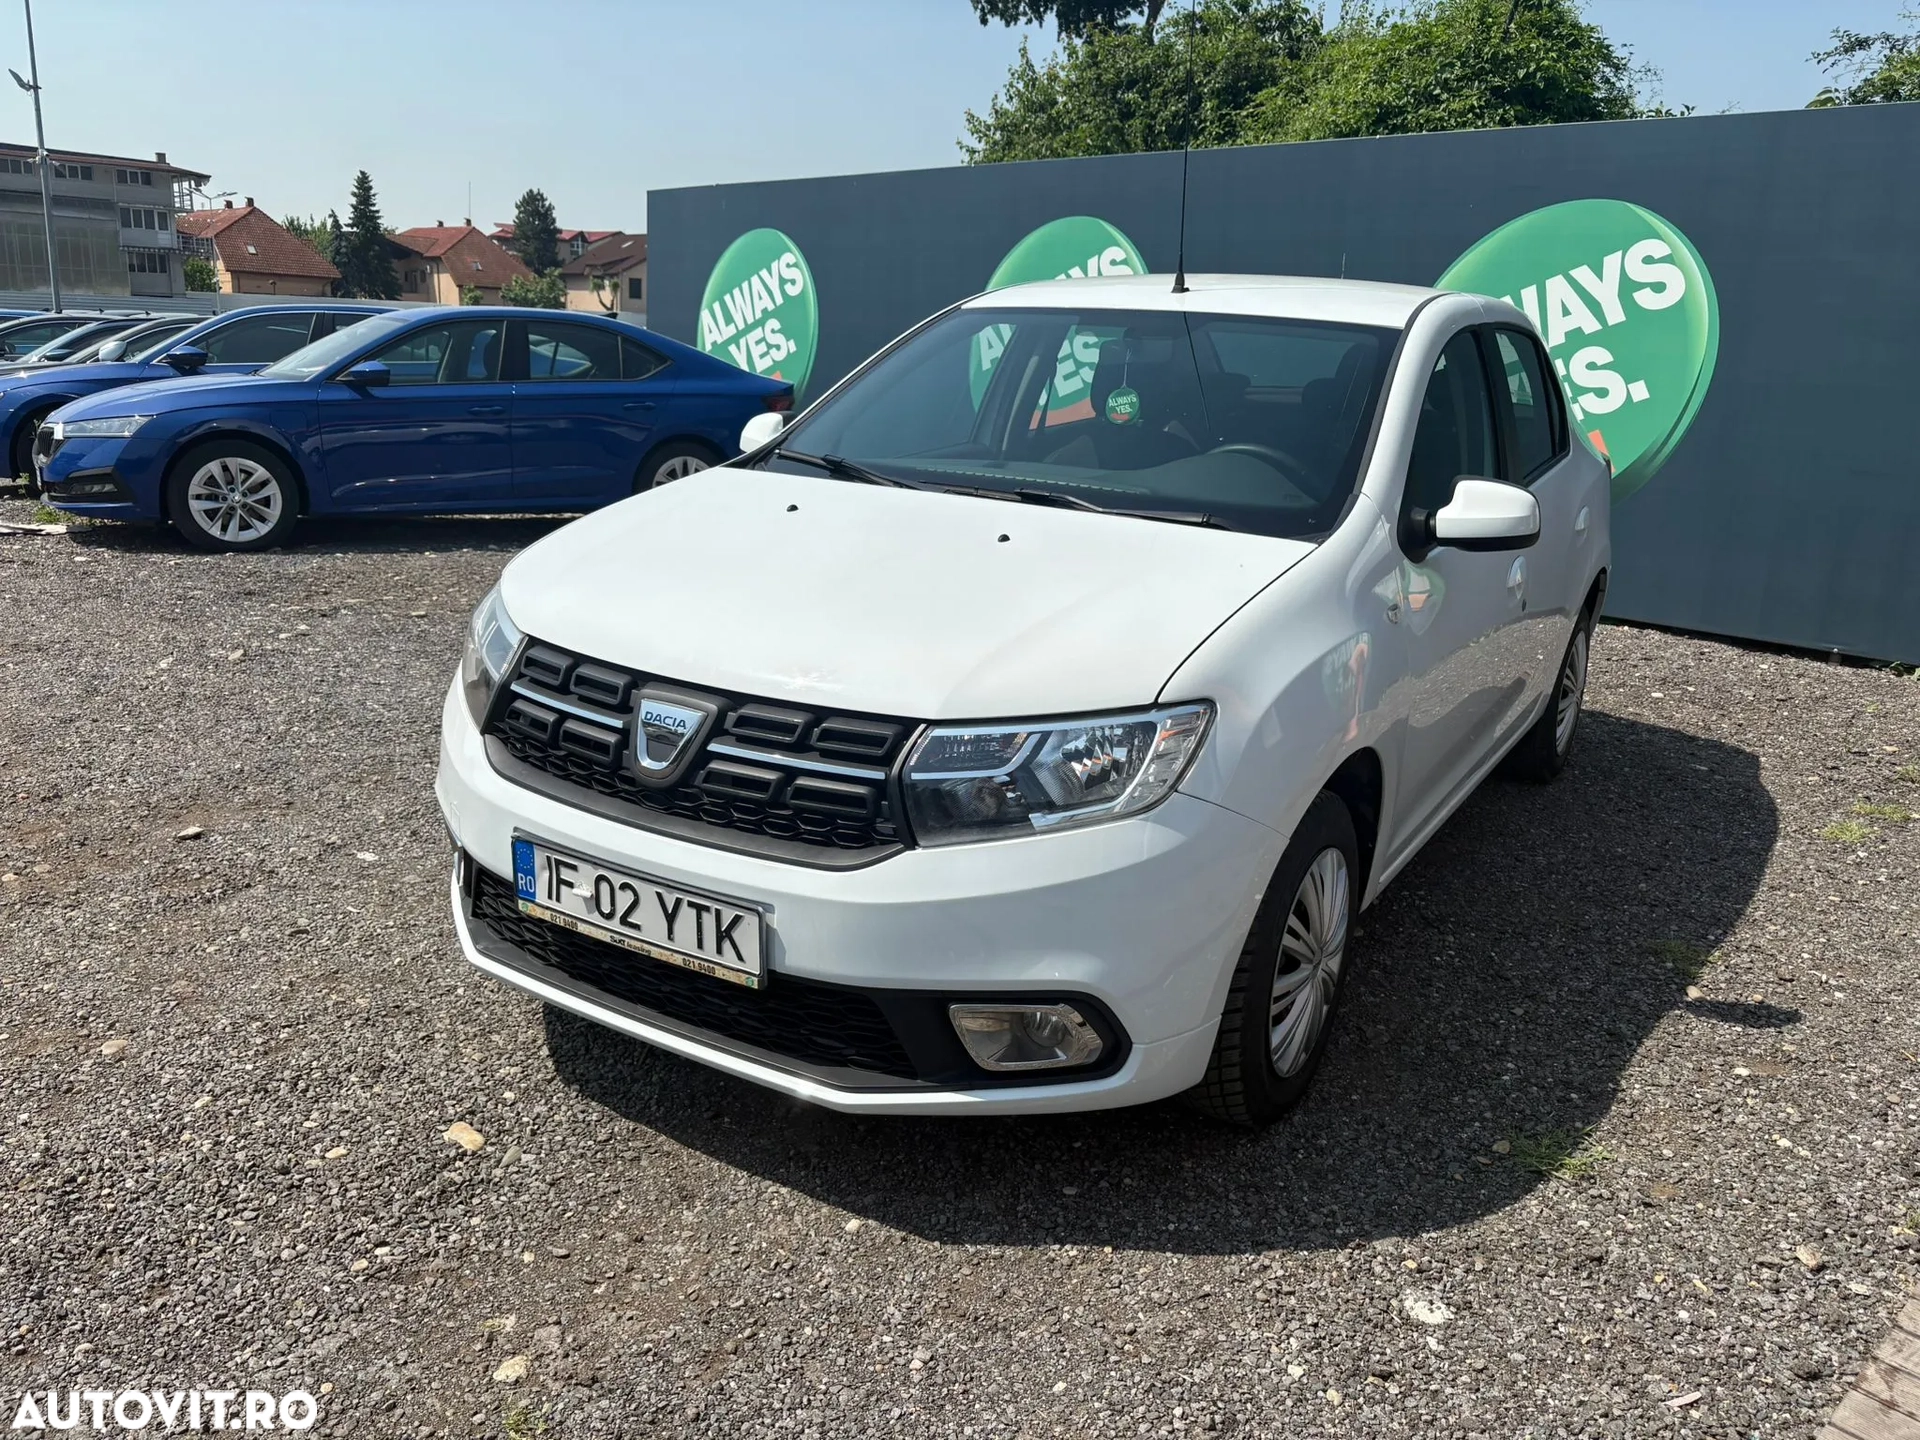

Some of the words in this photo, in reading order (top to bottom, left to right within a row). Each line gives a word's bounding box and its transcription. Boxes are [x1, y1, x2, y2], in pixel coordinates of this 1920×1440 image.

[701, 252, 804, 352] ALWAYS
[728, 318, 797, 373] YES.
[1109, 394, 1137, 407] ALWAYS
[644, 711, 687, 729] DACIA
[517, 873, 535, 893] RO
[545, 855, 579, 904] IF
[594, 873, 641, 932] 02
[655, 890, 745, 963] YTK
